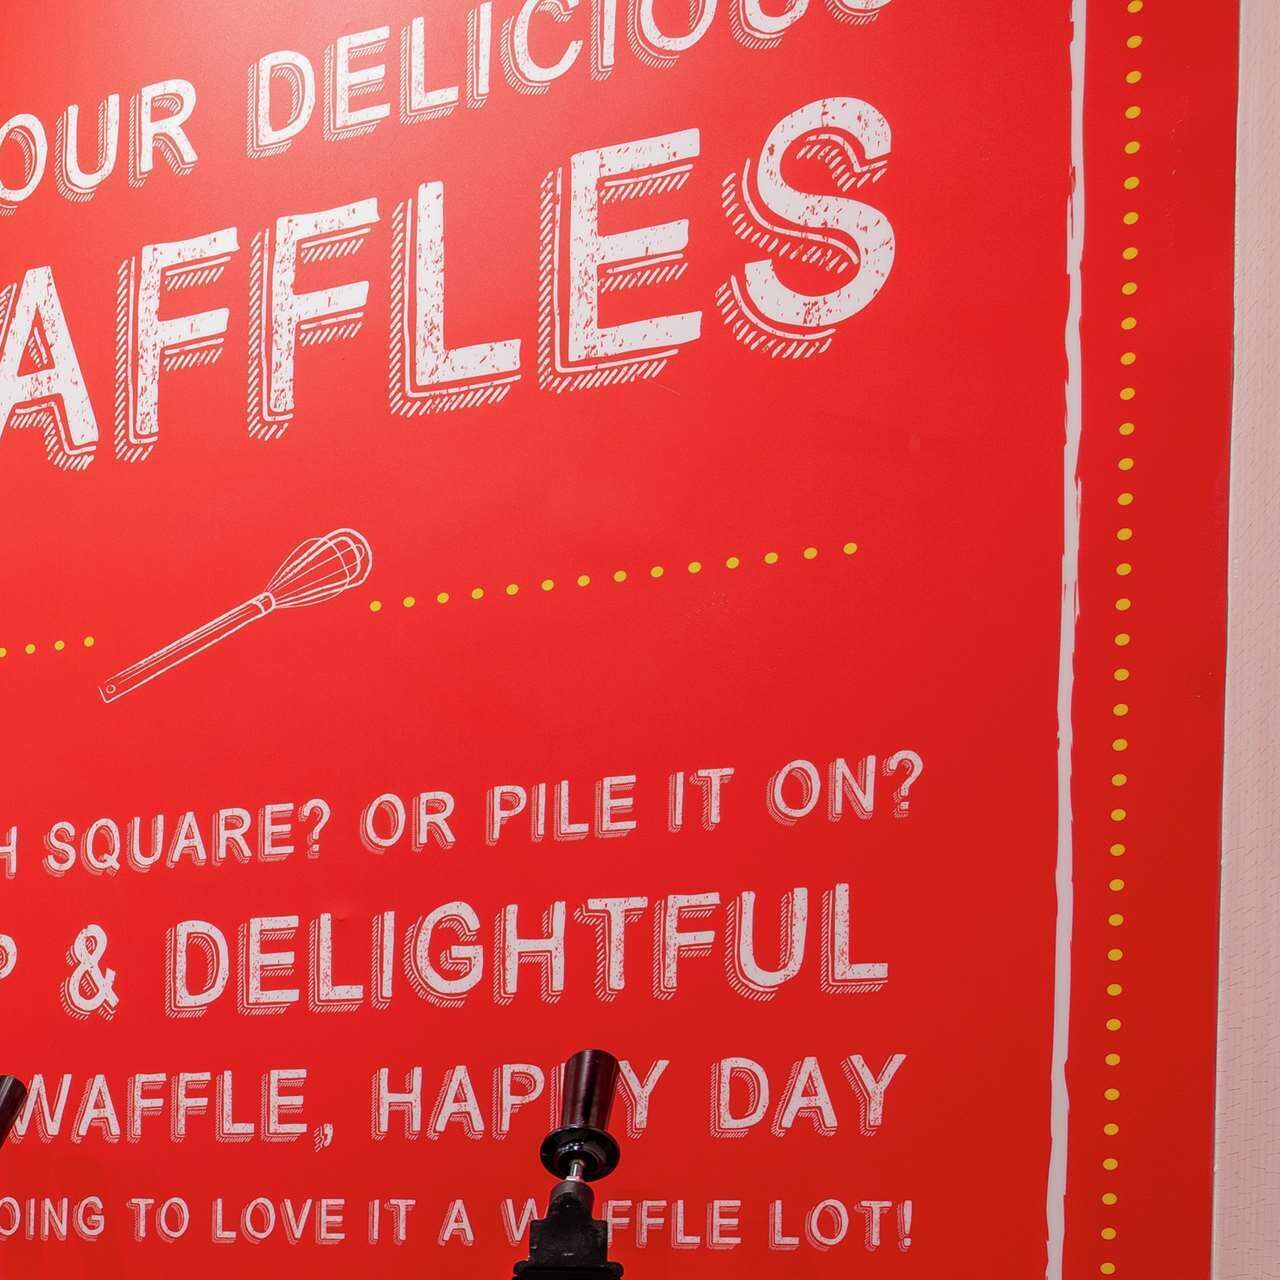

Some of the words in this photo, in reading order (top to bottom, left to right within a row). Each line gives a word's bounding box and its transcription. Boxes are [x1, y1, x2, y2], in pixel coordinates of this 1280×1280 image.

[247, 0, 891, 158] DELICIO
[42, 798, 331, 878] SQUARE?
[360, 791, 456, 854] OR
[485, 774, 636, 846] PILE
[668, 767, 735, 832] IT
[766, 750, 924, 826] ON?
[60, 924, 120, 1020] &
[165, 883, 889, 1019] DELIGHTFUL
[370, 1059, 670, 1141] HAPY
[710, 1054, 907, 1139] DAY
[126, 1197, 190, 1244] TO
[211, 1197, 345, 1245] LOVE
[368, 1198, 416, 1245] IT
[437, 1198, 474, 1246] A
[500, 1199, 741, 1250] WFFLE
[768, 1198, 914, 1251] LOT!
